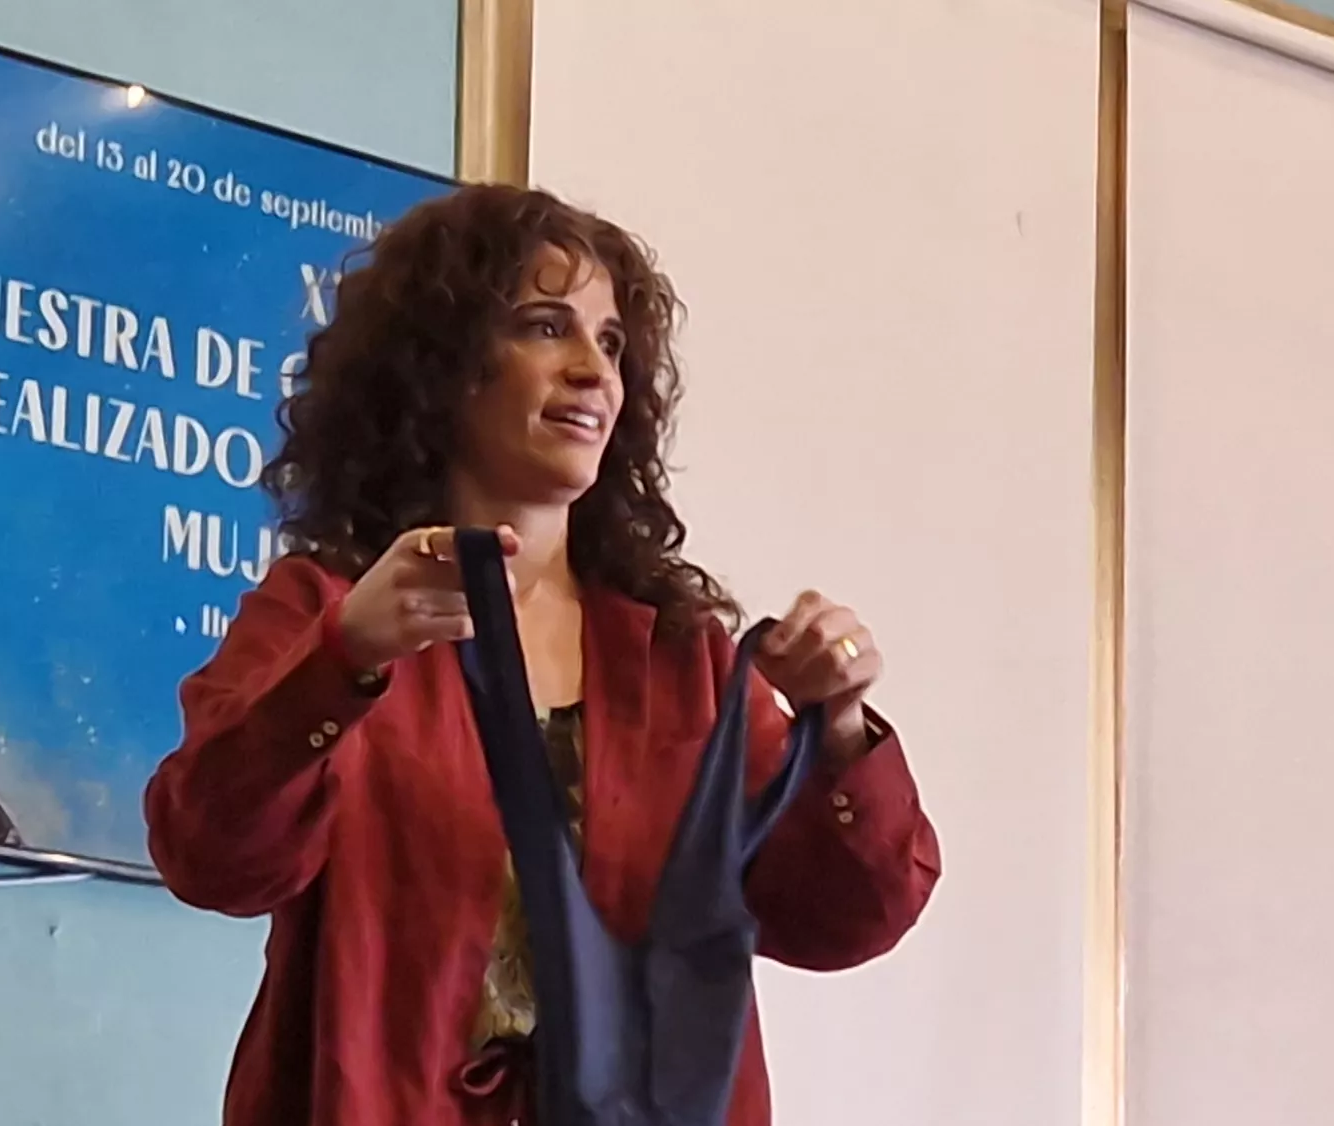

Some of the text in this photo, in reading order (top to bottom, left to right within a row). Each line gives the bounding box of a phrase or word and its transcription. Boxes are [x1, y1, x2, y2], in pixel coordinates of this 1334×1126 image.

[35, 121, 386, 241] del 13 al 20 de septiemb
[195, 326, 266, 401] DE
